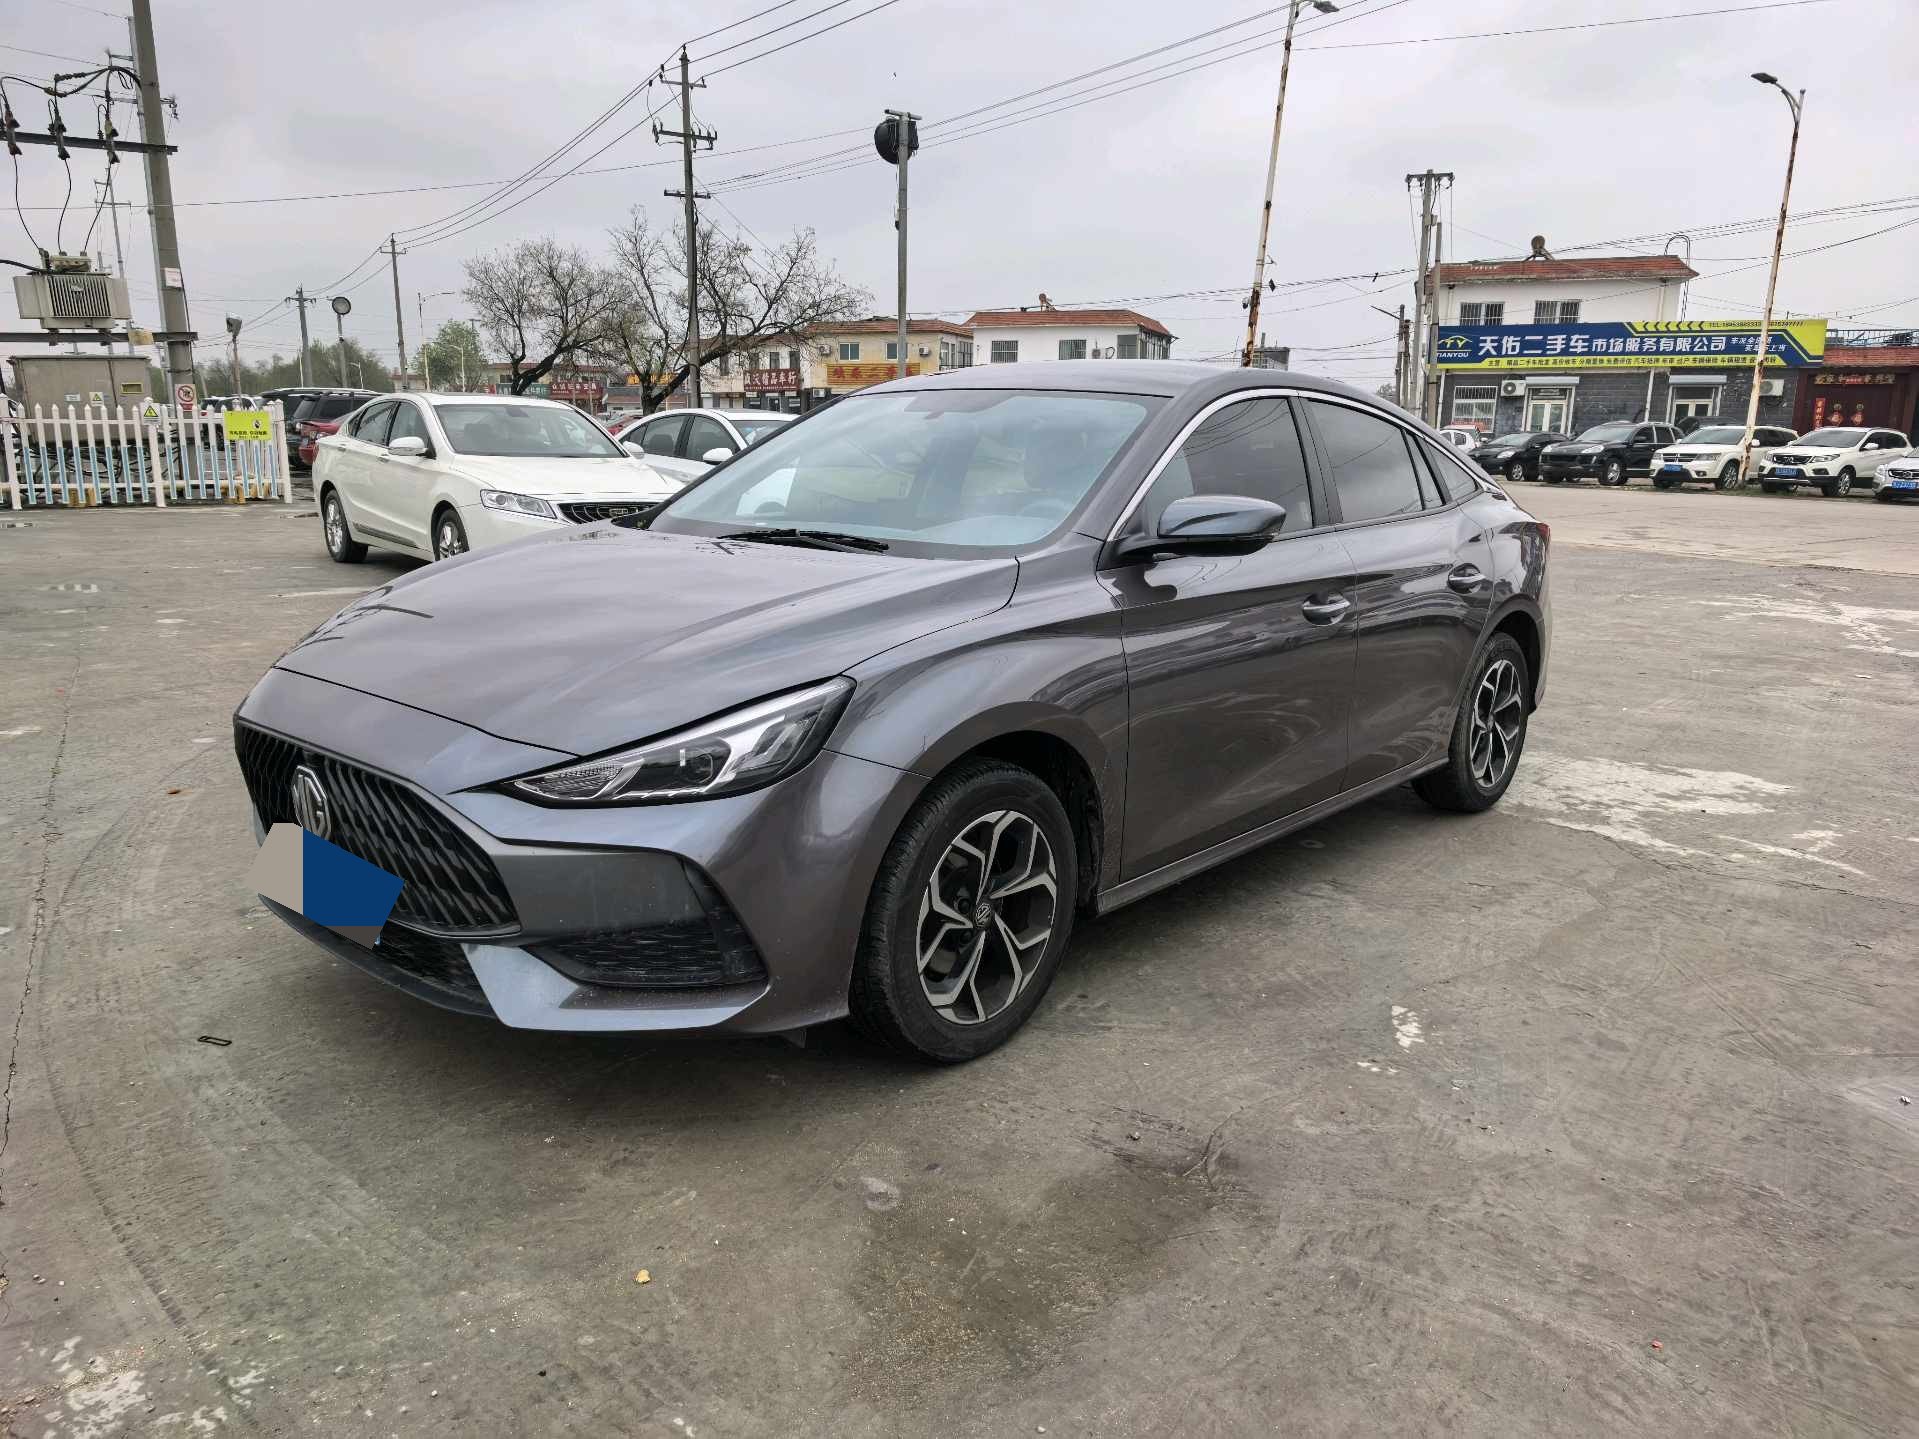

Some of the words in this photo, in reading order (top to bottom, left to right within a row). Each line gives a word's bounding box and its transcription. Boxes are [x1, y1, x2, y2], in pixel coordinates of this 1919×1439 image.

[1477, 334, 1727, 355] 天佑二手车市场服务有限公司
